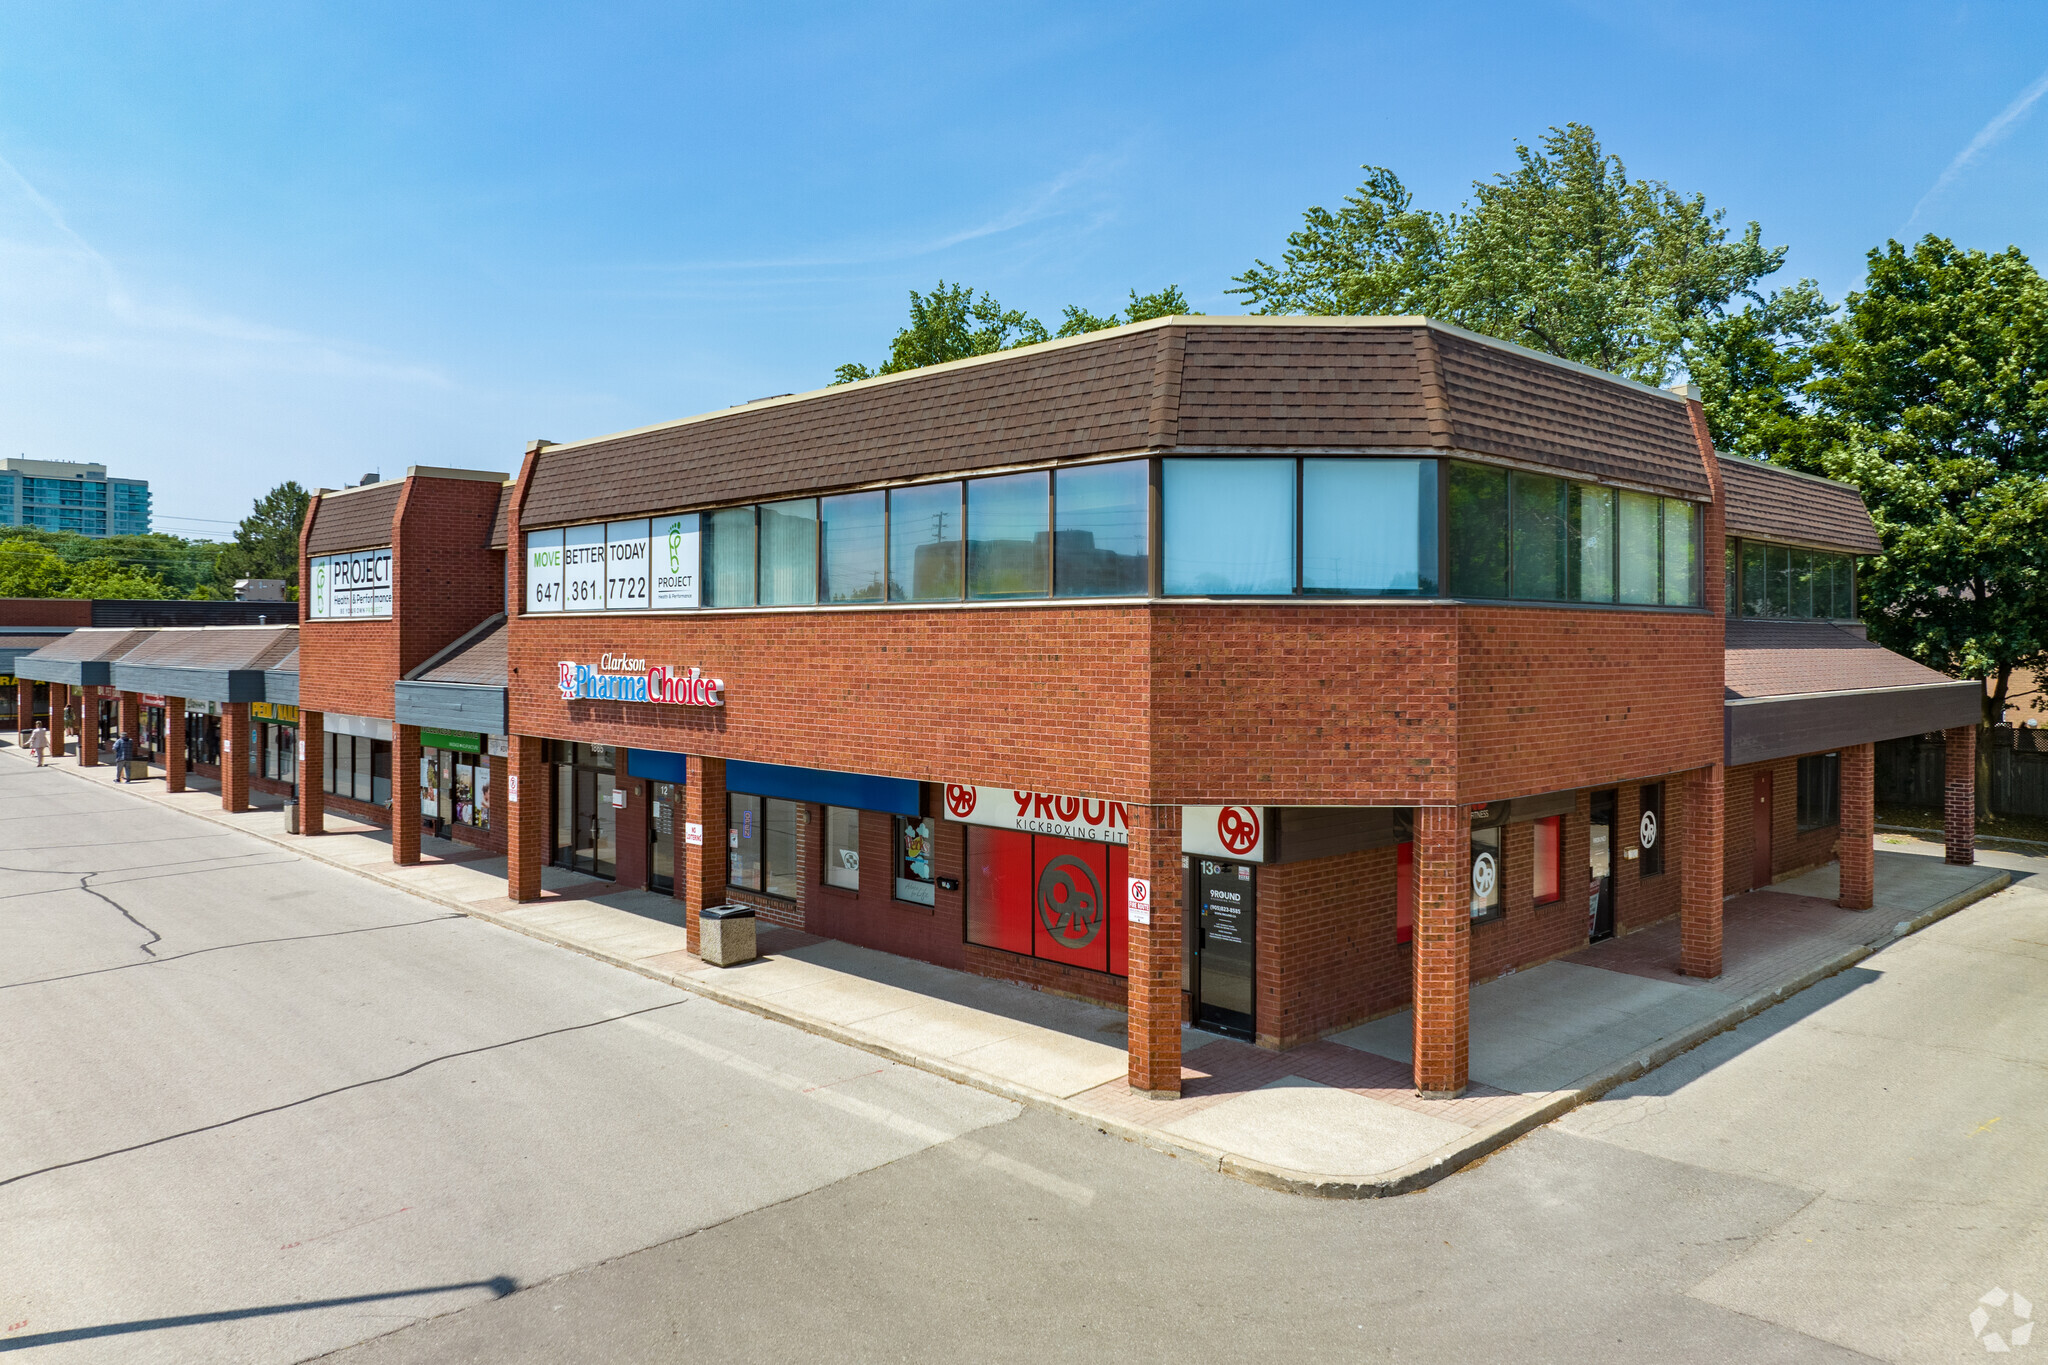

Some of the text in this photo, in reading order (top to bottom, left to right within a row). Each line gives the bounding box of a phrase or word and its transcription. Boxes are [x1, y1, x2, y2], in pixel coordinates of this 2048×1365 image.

[534, 542, 646, 567] MOVE BETTER TODAY
[334, 556, 391, 585] PROJECT
[536, 583, 561, 602] 647
[609, 577, 646, 599] 7722
[658, 576, 692, 588] PROJECT
[334, 593, 392, 605] Health & Performance
[601, 652, 646, 671] Clarkson
[575, 664, 718, 706] PharmaChoice
[660, 786, 668, 796] 12
[1016, 819, 1128, 845] KICKBOXING FIT
[1201, 860, 1214, 876] 13
[1210, 889, 1241, 902] 9ROUND
